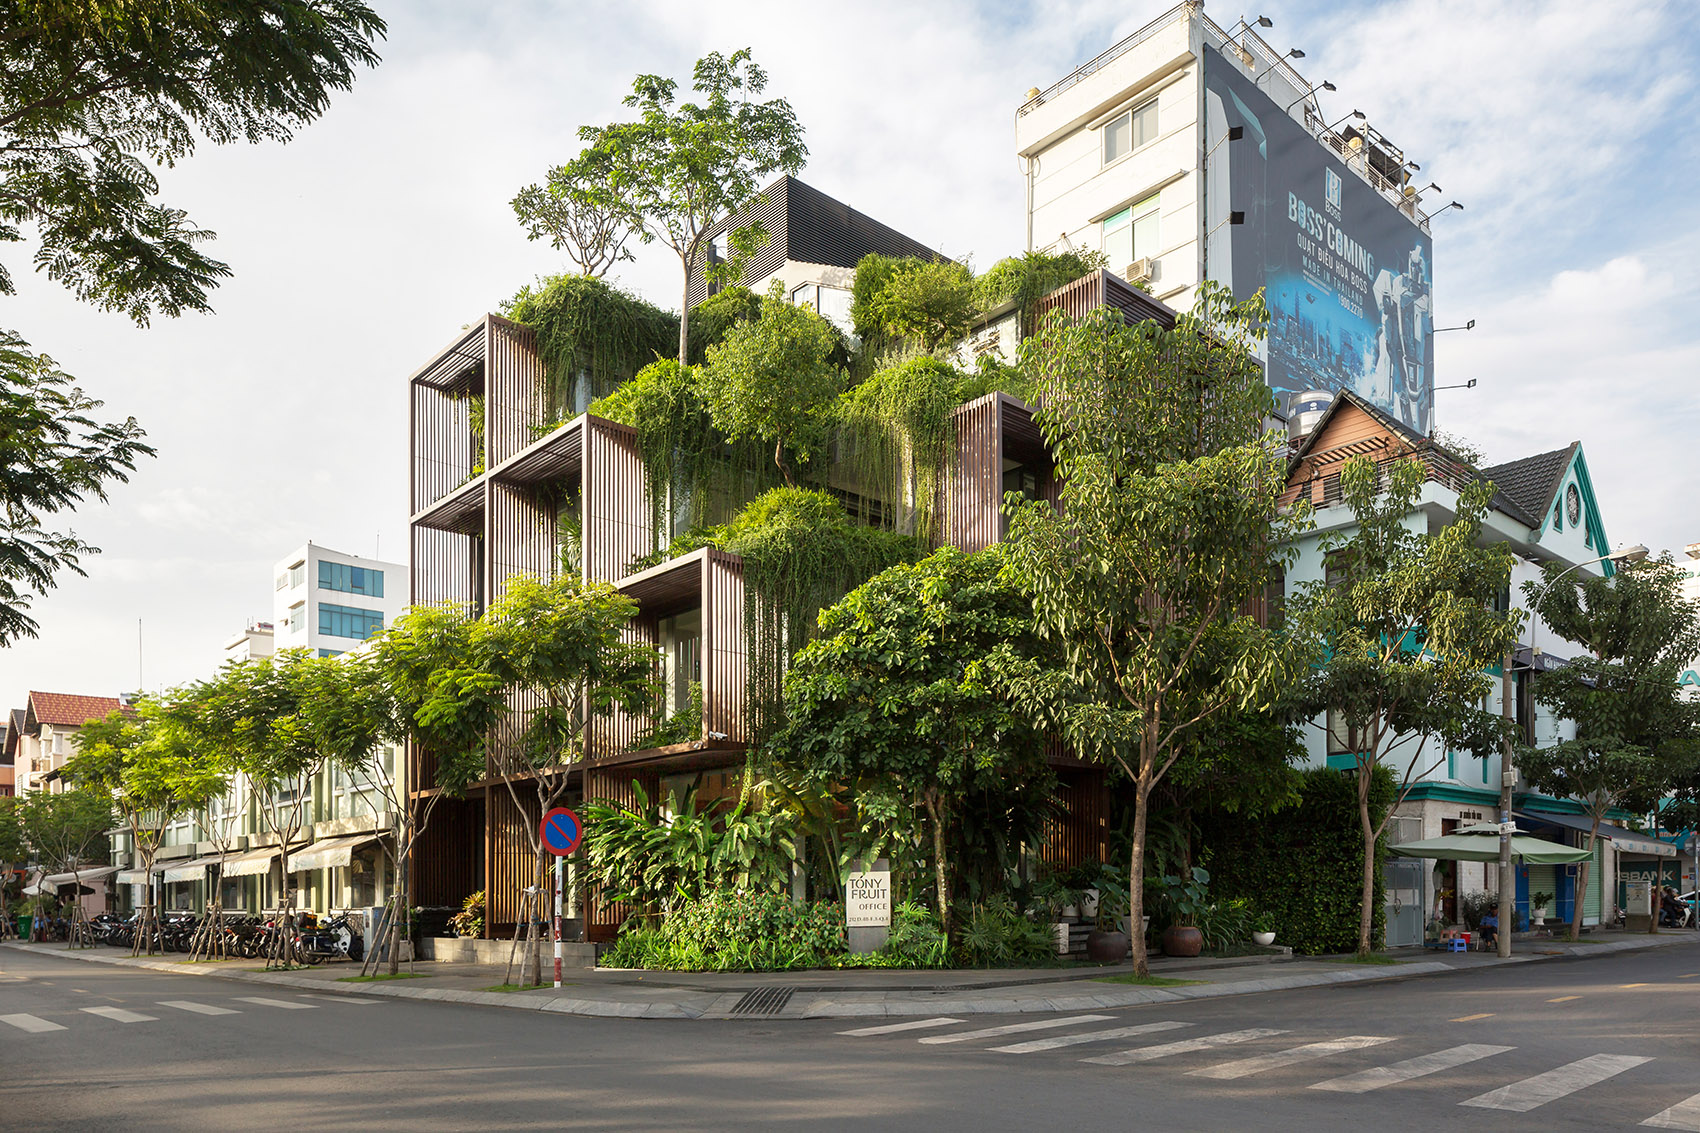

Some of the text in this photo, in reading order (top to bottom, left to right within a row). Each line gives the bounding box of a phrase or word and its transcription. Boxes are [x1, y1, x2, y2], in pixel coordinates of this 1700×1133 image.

[1325, 199, 1341, 222] BOSS
[1303, 255, 1320, 276] MADE
[1323, 269, 1330, 283] IN
[1333, 276, 1363, 306] THAILAND
[1351, 271, 1367, 294] BOSS
[851, 889, 887, 899] FRUIT
